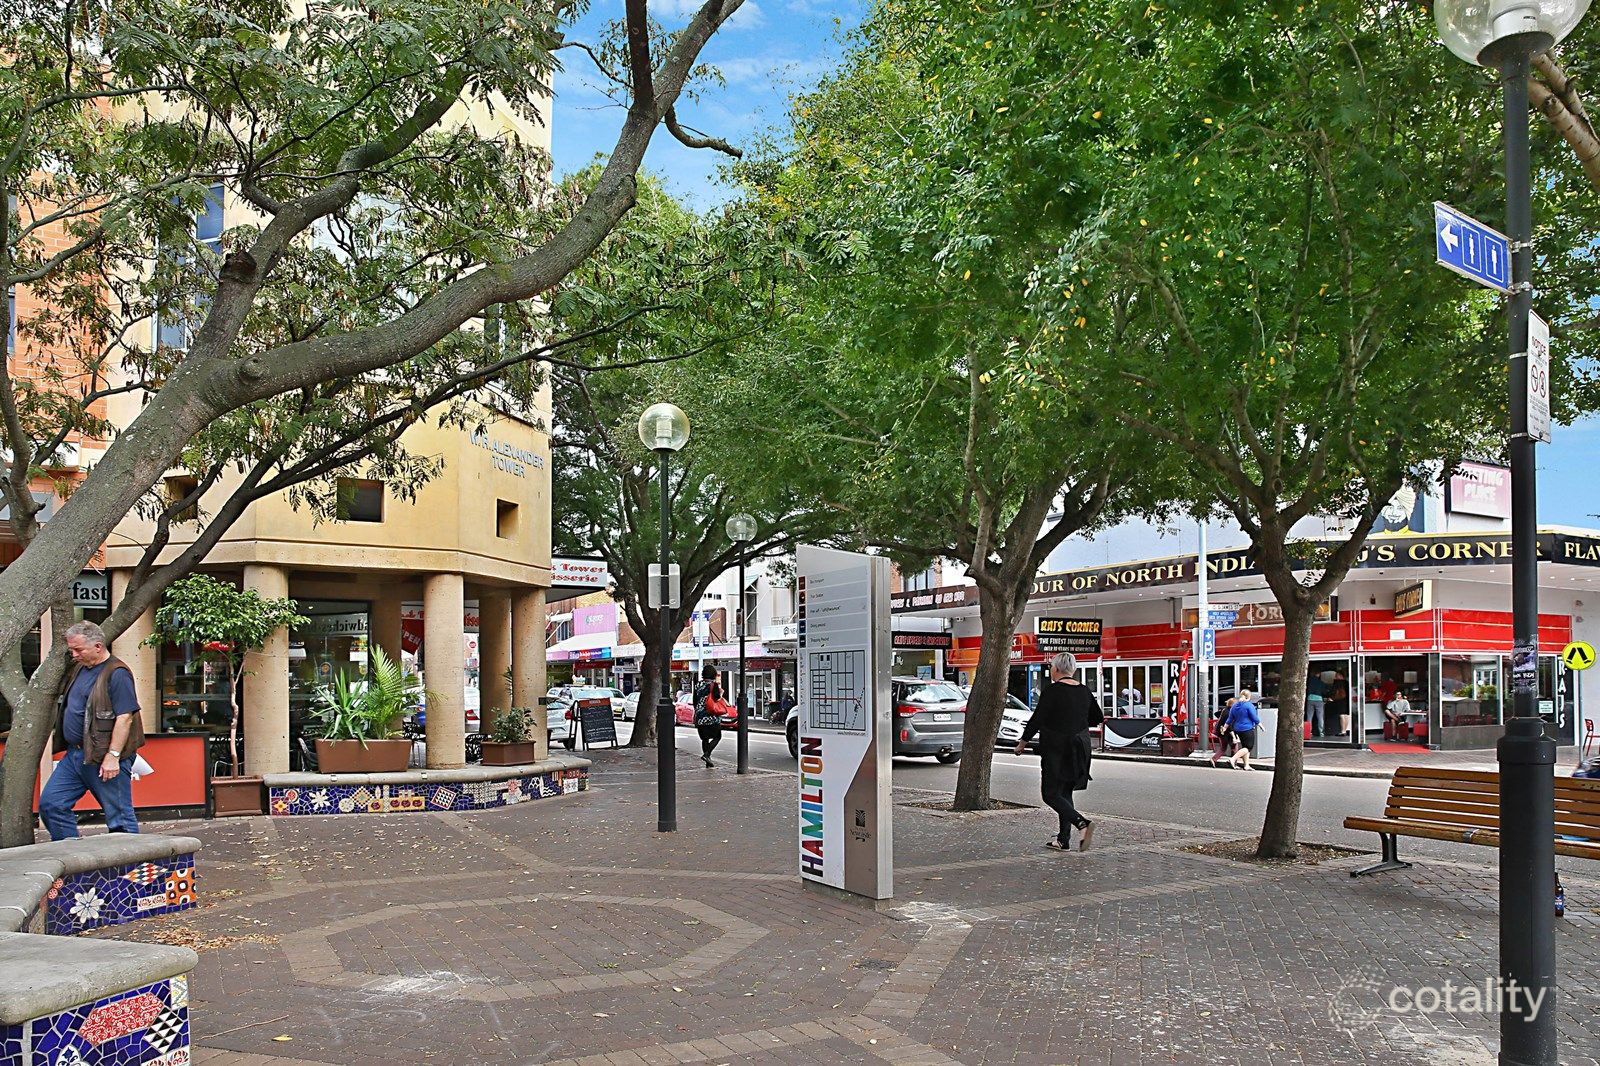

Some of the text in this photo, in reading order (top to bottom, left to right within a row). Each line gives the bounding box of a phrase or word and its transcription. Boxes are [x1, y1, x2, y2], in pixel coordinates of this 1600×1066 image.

[492, 440, 544, 470] ALEXANDER
[492, 455, 525, 478] TOWER
[560, 563, 606, 573] Tower
[1072, 576, 1098, 590] OF
[1106, 564, 1183, 586] NORTH
[1065, 621, 1100, 633] CORNER
[1067, 638, 1084, 646] INDIAN
[1085, 638, 1099, 646] FOOD
[800, 736, 824, 878] HAMILTON
